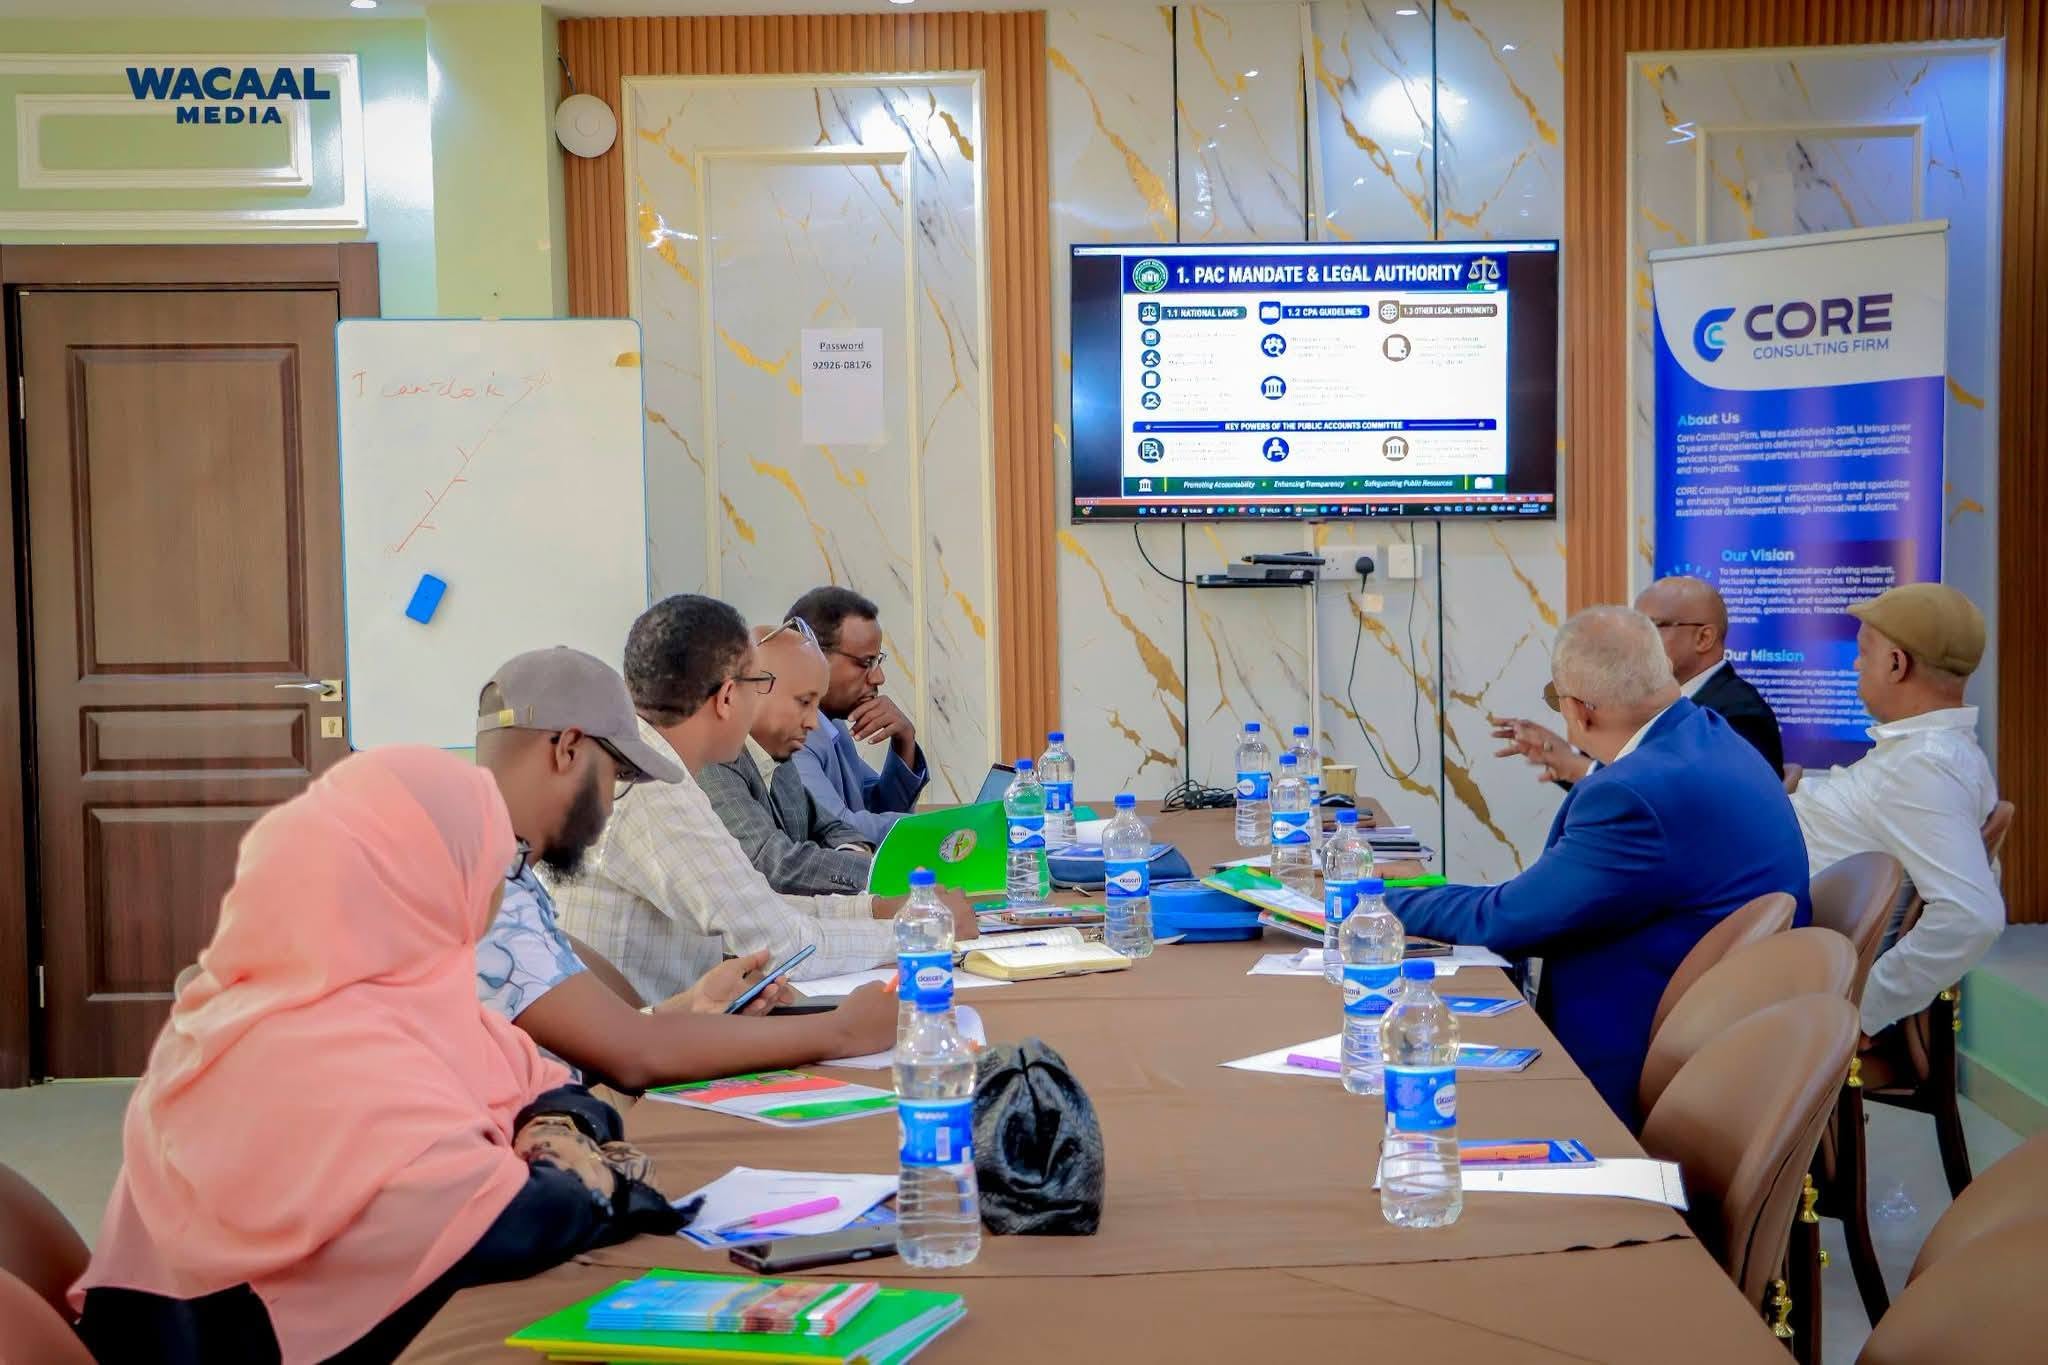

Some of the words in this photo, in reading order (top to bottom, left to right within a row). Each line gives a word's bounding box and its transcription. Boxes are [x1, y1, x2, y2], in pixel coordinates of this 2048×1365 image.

[1177, 268, 1189, 284] 1.
[1195, 267, 1224, 283] PAC
[1229, 267, 1302, 283] MANDATE
[1306, 266, 1320, 282] &
[1323, 265, 1371, 282] LEGAL
[1374, 264, 1462, 282] AUTHORITY
[1167, 309, 1178, 318] 1.1
[1180, 308, 1216, 318] NATIONAL
[1218, 308, 1239, 317] LAWS
[1287, 308, 1300, 317] 1.2
[1303, 307, 1318, 317] CPA
[1319, 306, 1363, 317] GUIDELINES
[1414, 306, 1433, 315] OTHER
[1434, 306, 1453, 315] LEGAL
[1454, 305, 1494, 315] INSTRUMENTS
[1744, 293, 1893, 342] CORE
[819, 340, 864, 350] Password
[1752, 340, 1848, 360] CONSULTING
[1852, 338, 1889, 353] FIRM
[812, 361, 872, 369] 92926-08176
[1678, 414, 1719, 426] About
[1721, 412, 1741, 424] Us
[1224, 423, 1240, 431] KEY
[1241, 423, 1270, 431] POWERS
[1271, 422, 1281, 431] OF
[1283, 422, 1296, 431] THE
[1297, 422, 1322, 431] PUBLIC
[1324, 421, 1361, 430] ACCOUNTS
[1362, 421, 1403, 430] COMMITTEE
[1696, 431, 1739, 442] Consulting
[1676, 486, 1698, 496] CORE
[1699, 484, 1742, 496] Consulting
[1846, 492, 1863, 501] and
[1721, 550, 1748, 562] Our
[1750, 548, 1795, 561] Vision
[1845, 575, 1861, 584] the
[1751, 648, 1804, 661] Mission
